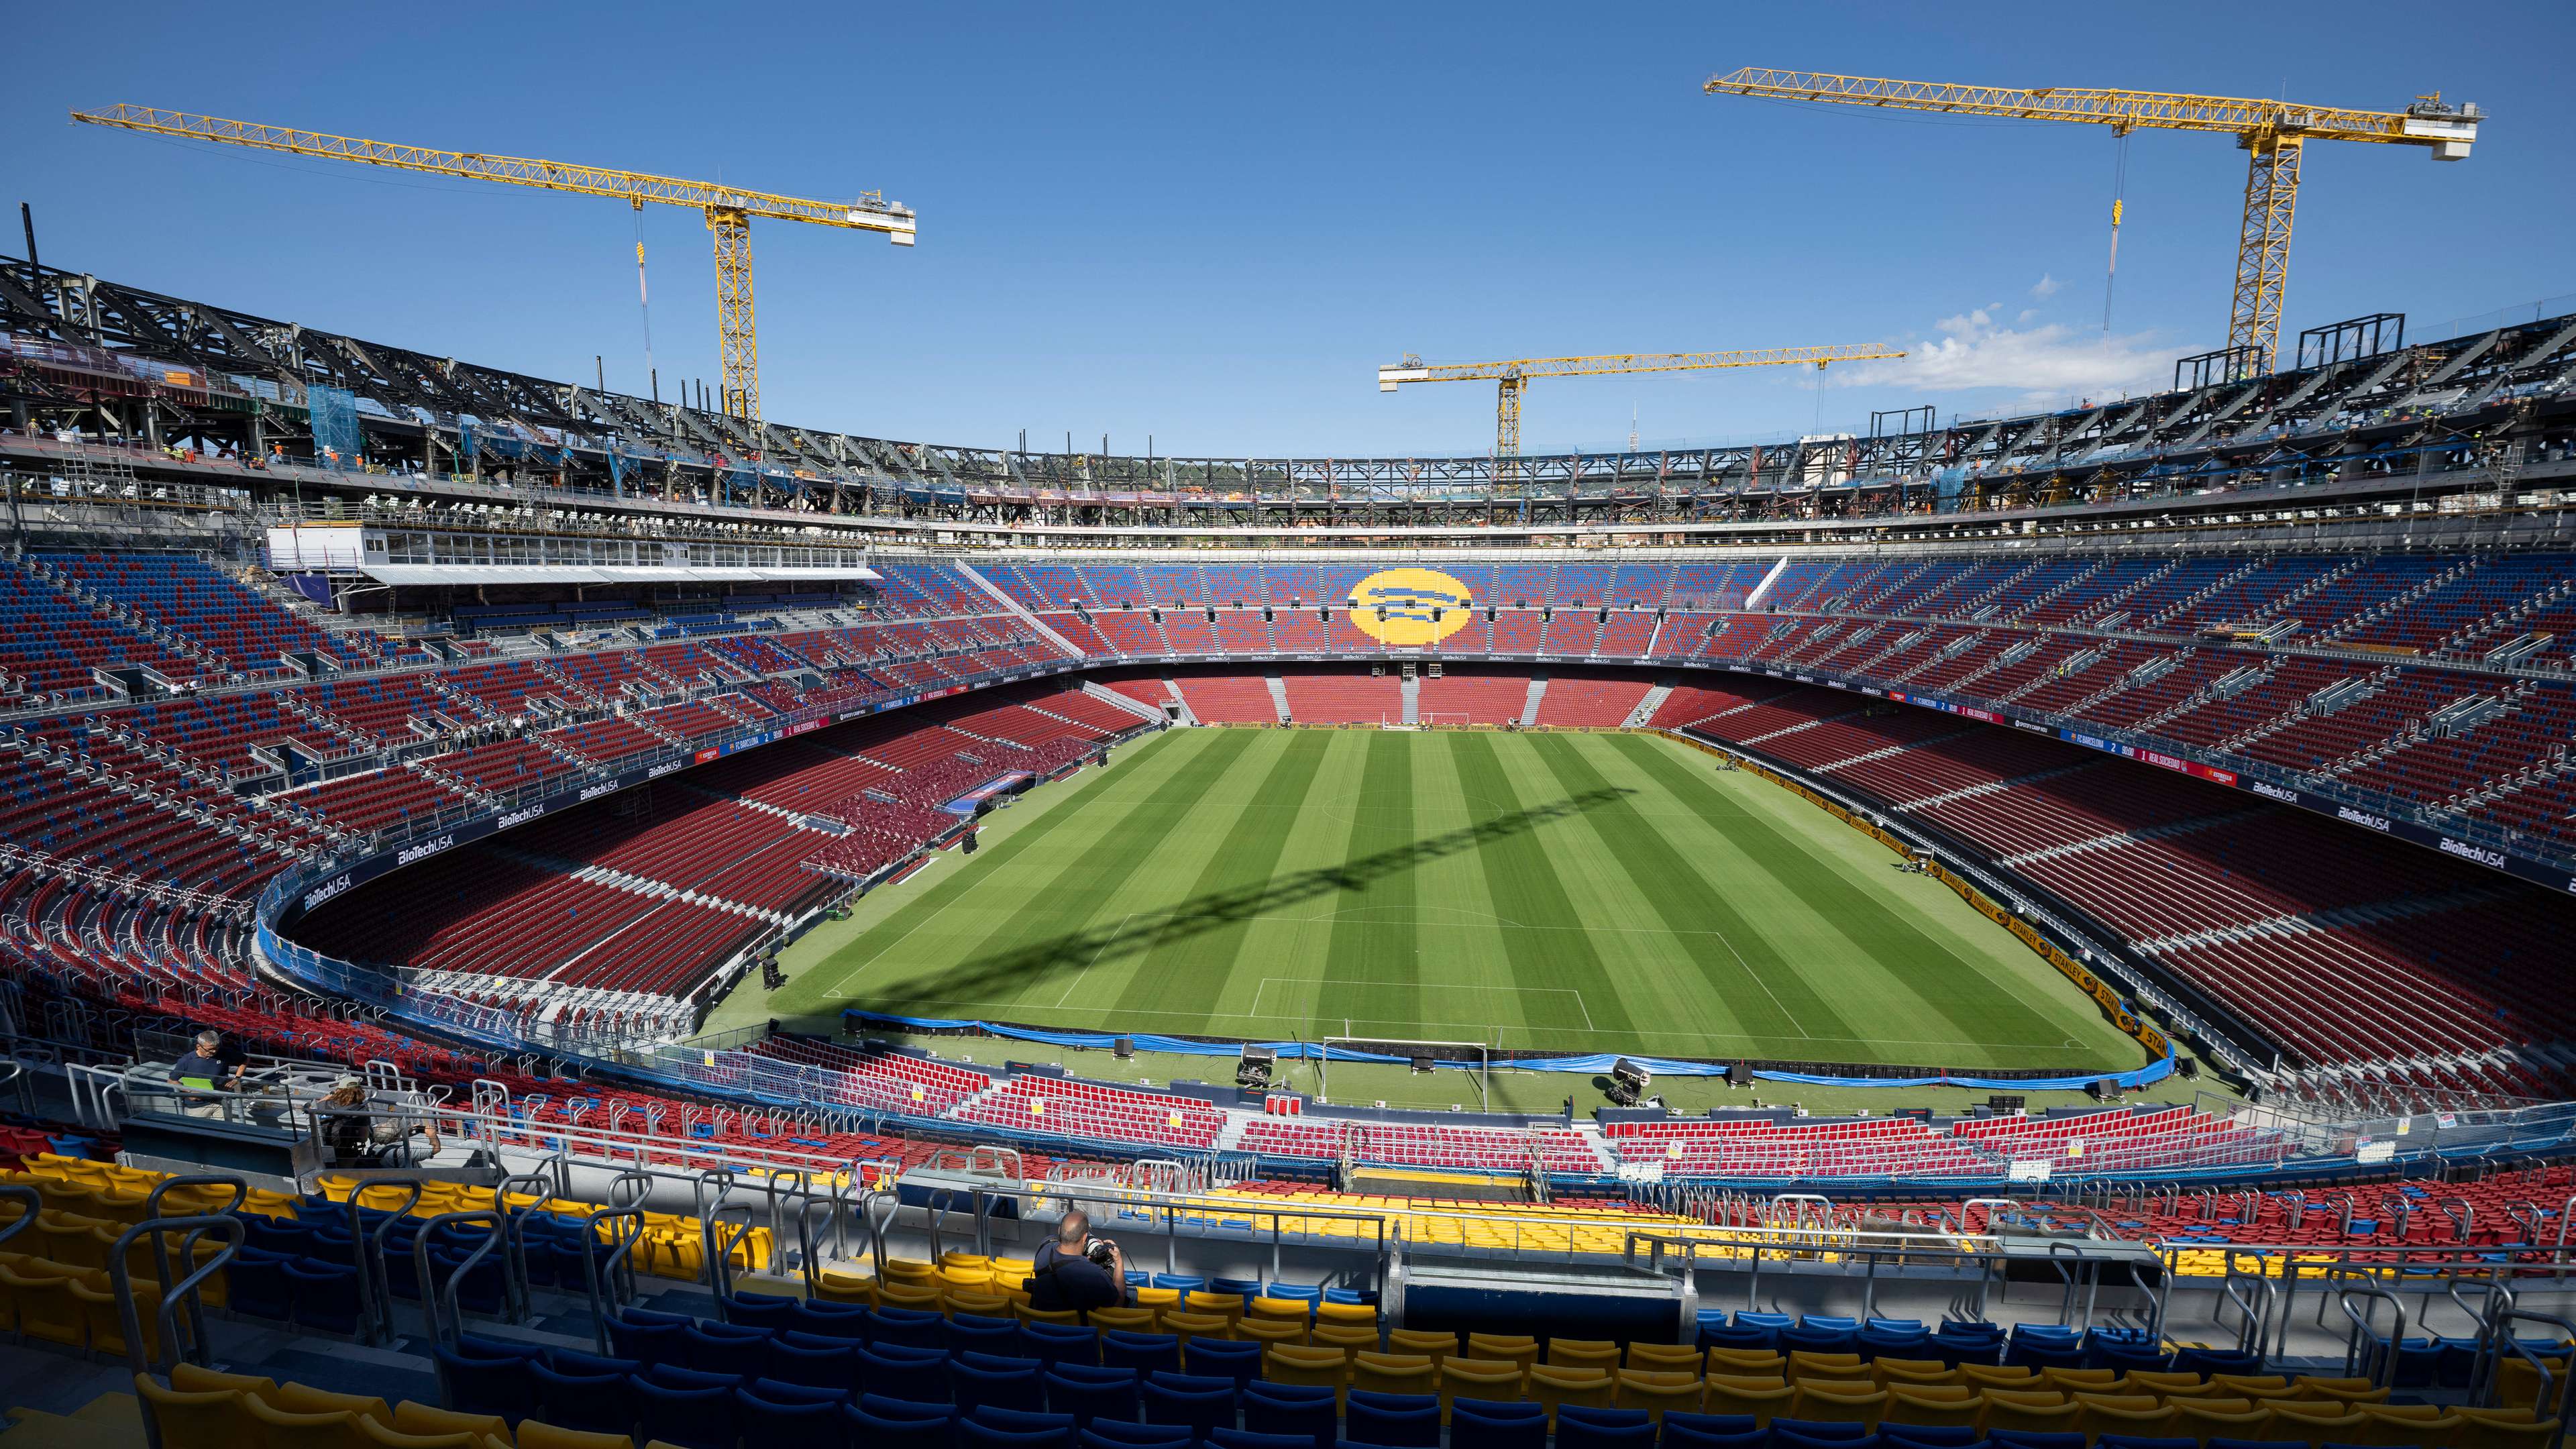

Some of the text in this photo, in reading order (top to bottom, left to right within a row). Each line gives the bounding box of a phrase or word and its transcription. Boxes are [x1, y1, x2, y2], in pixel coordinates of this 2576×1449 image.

[765, 733, 769, 742] 2
[788, 727, 792, 735] 1
[2077, 734, 2180, 769] FC BARCELONA 2 90:00 1 REAL SOCIEDAD
[649, 759, 682, 777] BioTechUSA
[580, 780, 619, 800] BioTechUSA
[2253, 782, 2297, 803] BioTechUSA
[498, 804, 544, 828] BioTechUSA
[1851, 819, 1870, 833] STANLEY
[2338, 806, 2389, 832] BioTechUSA
[398, 835, 453, 865] BioTechUSA
[1882, 835, 1900, 849] STANLEY
[2439, 837, 2504, 869] BioTechUSA
[1945, 872, 1964, 890] STANLEY
[305, 874, 351, 910] BioTechUSA
[1974, 896, 1994, 915] STANLEY
[2012, 922, 2037, 945] STANLEY
[2054, 953, 2081, 975] STANLEY
